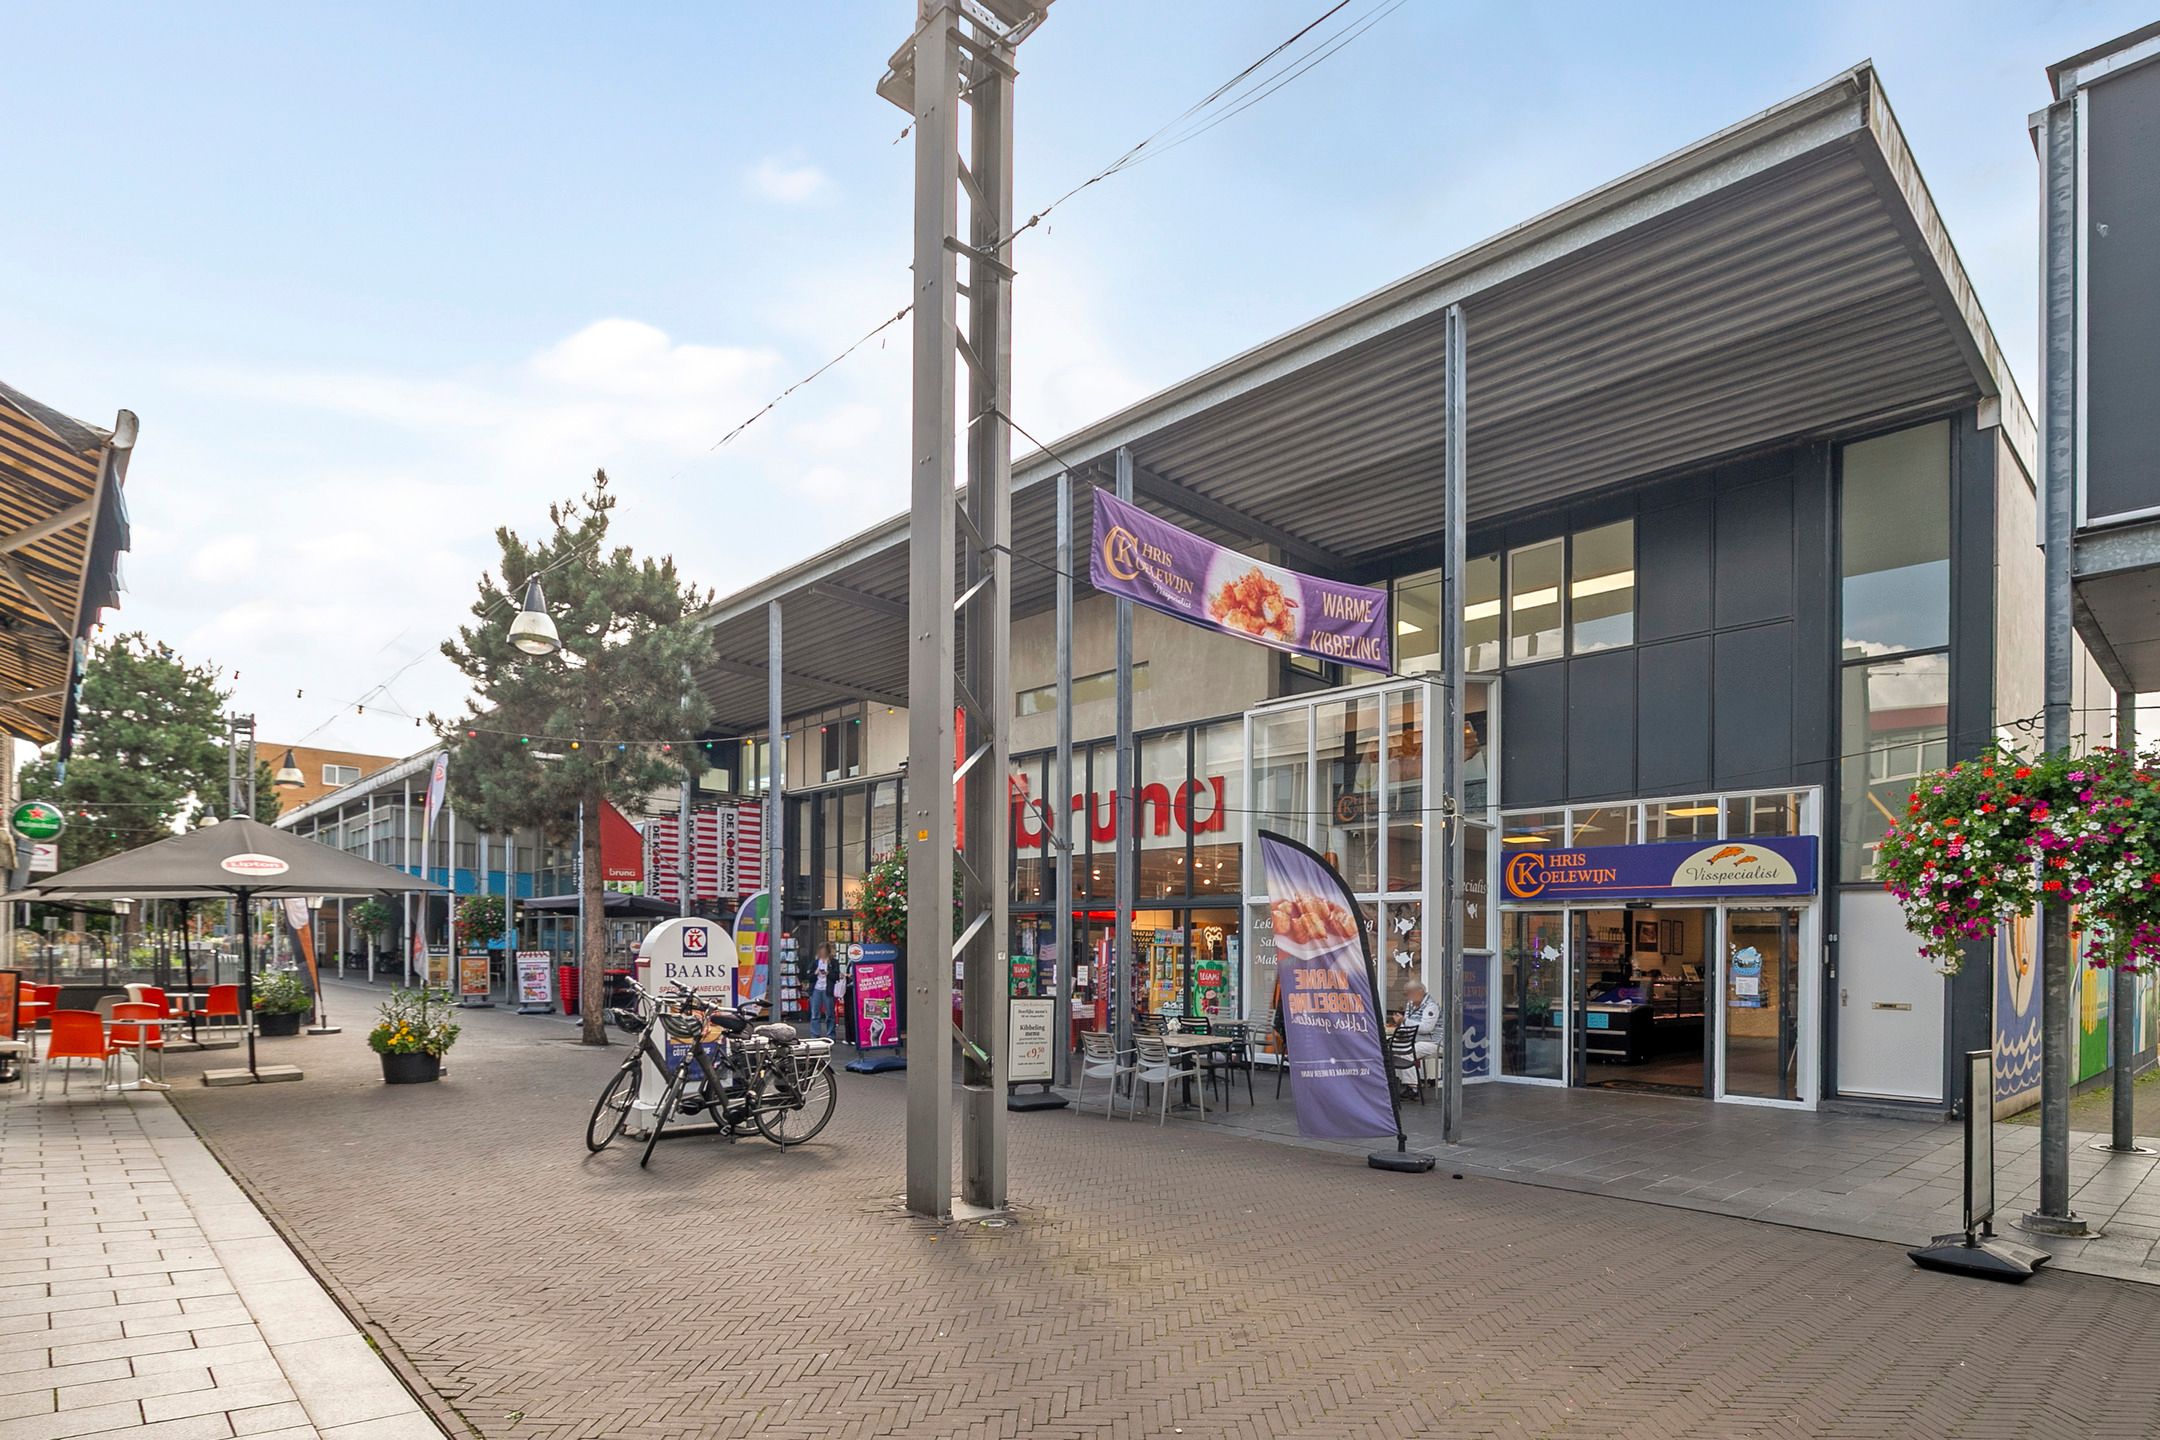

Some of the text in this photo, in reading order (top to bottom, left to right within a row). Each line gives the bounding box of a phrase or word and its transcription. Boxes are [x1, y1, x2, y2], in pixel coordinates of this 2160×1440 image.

[1323, 592, 1374, 623] WARME
[1310, 630, 1381, 661] KIBBELING
[1010, 774, 1225, 849] buna
[652, 825, 660, 839] DE
[726, 813, 736, 892] DE KOOPMAN
[609, 868, 636, 877] bruna
[1685, 865, 1779, 884] Visspecialist
[688, 934, 702, 948] K
[665, 963, 726, 978] BAARS
[1020, 1024, 1046, 1032] Kibbeling
